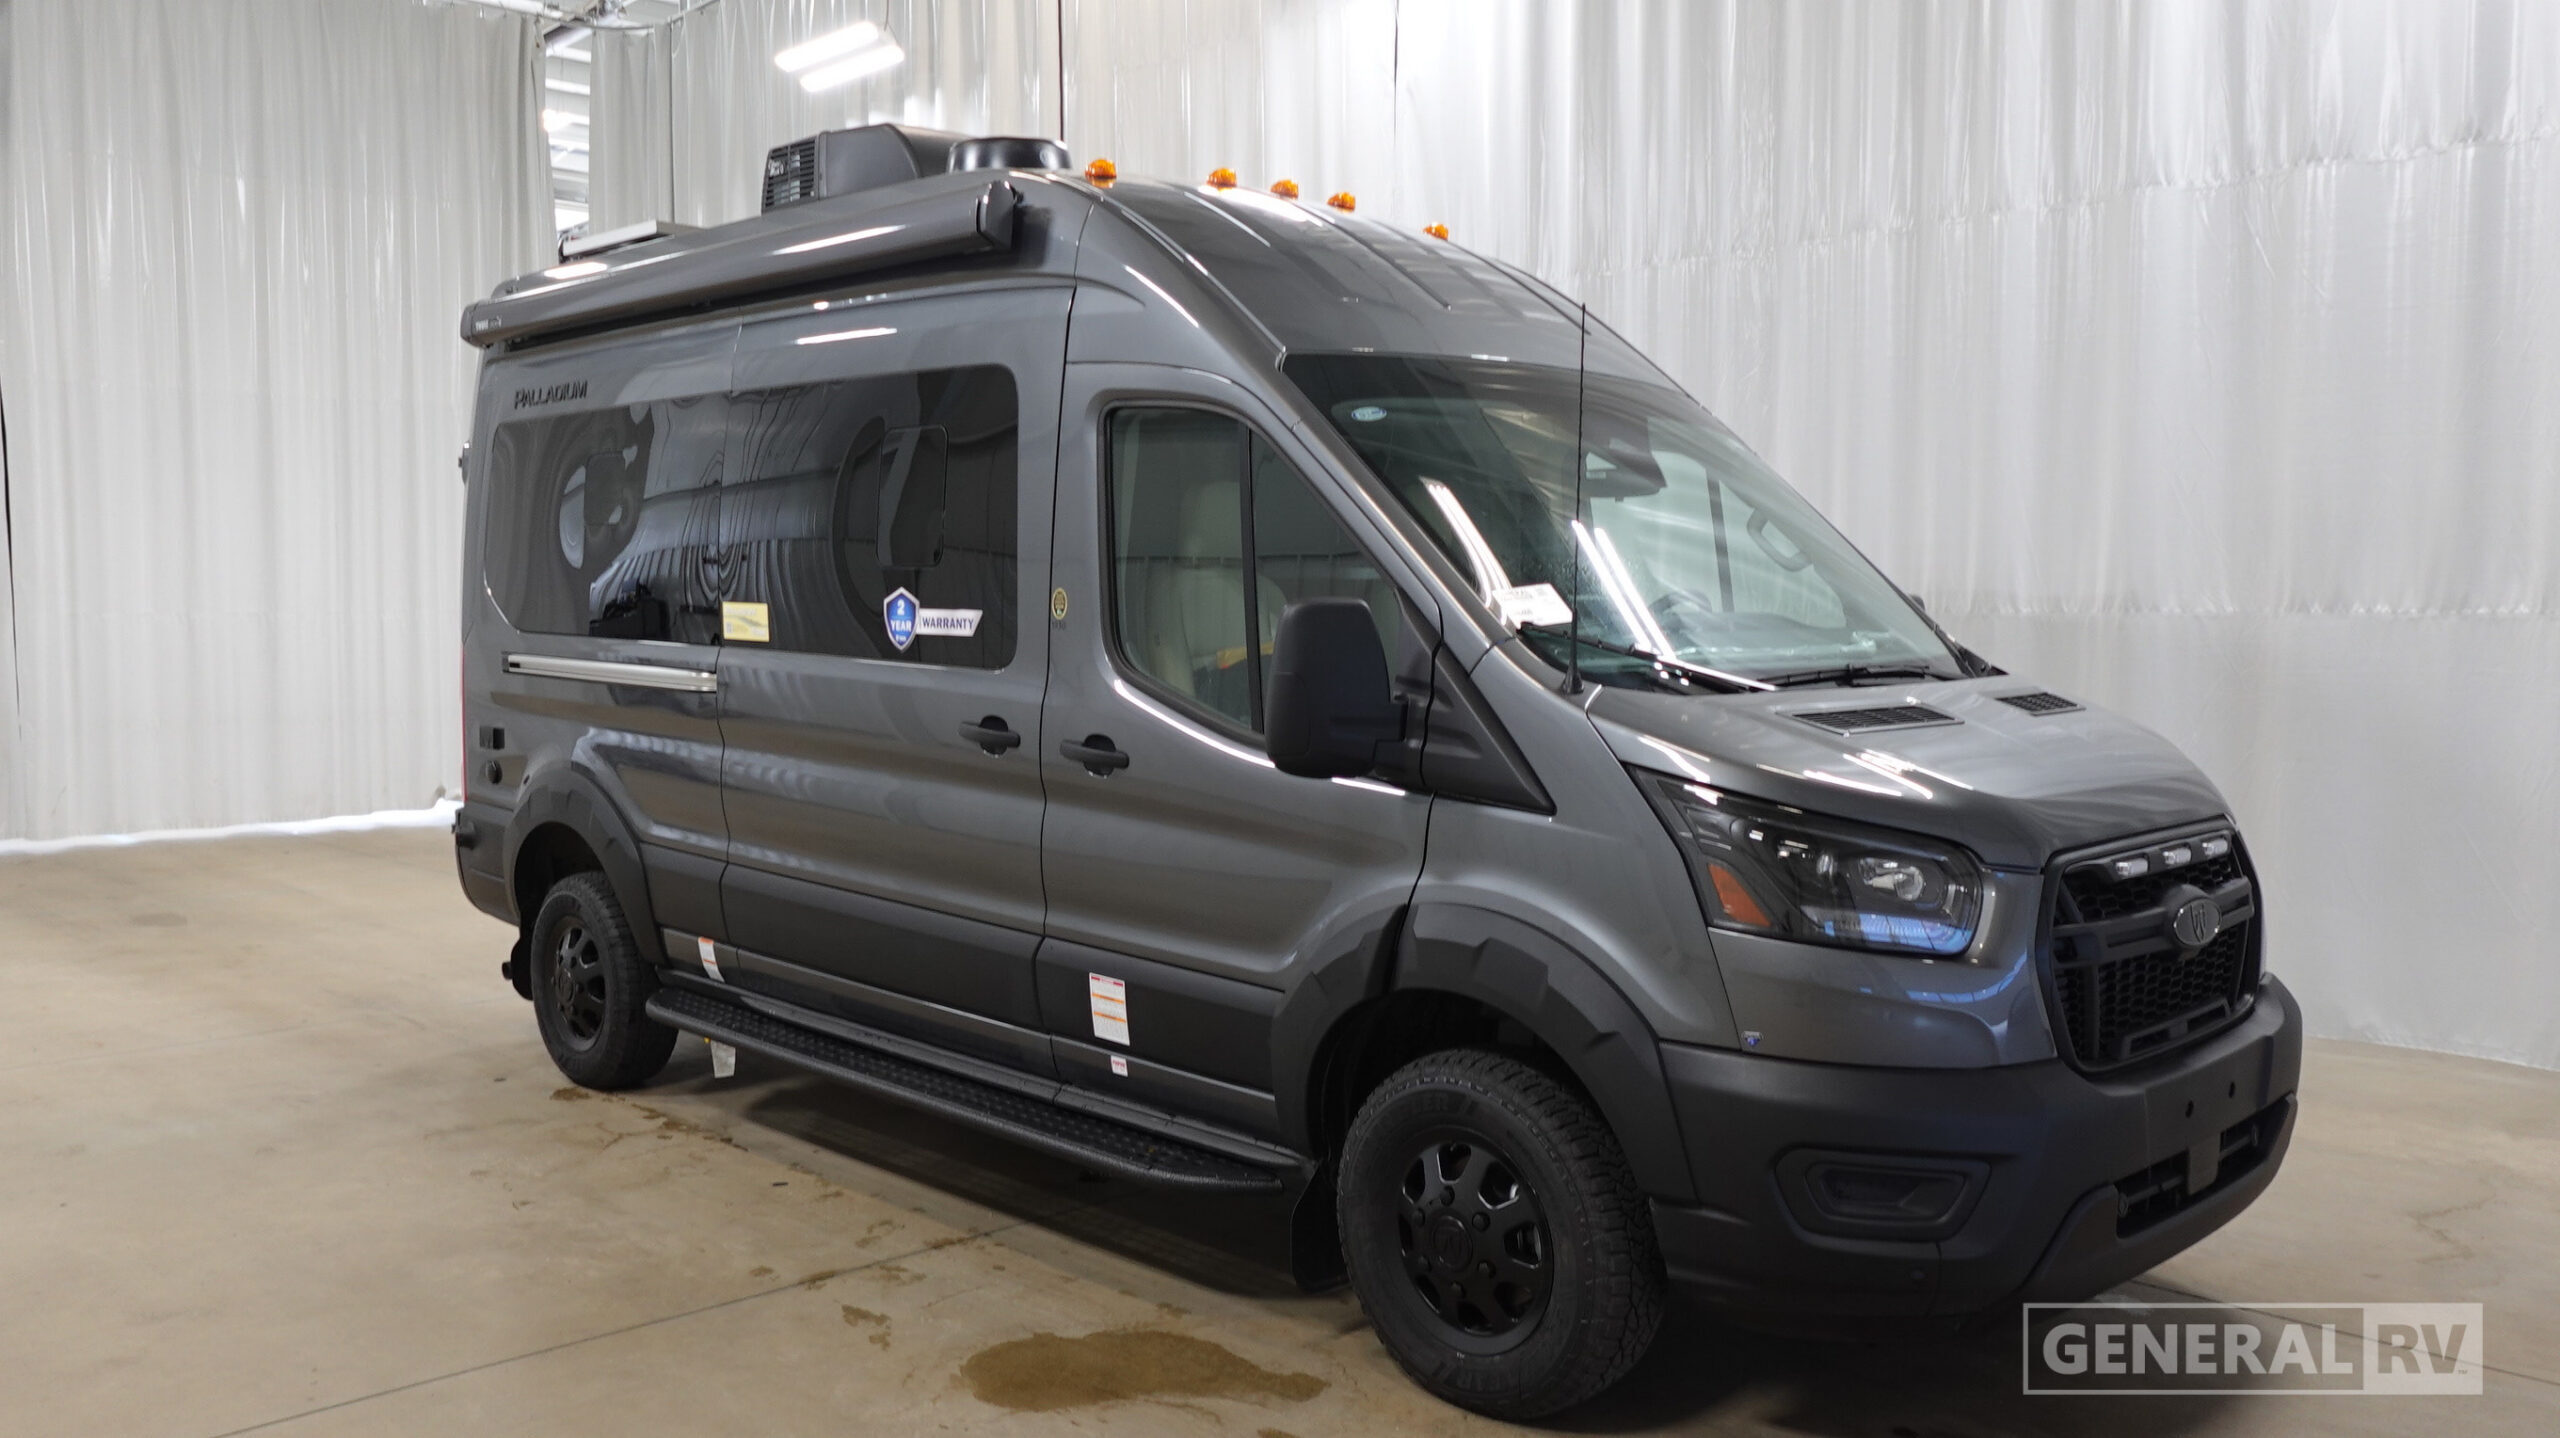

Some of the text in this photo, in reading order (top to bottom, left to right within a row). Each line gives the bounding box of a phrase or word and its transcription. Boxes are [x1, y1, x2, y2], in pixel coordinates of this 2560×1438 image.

[514, 380, 588, 409] PALLADIUM
[897, 599, 905, 616] 2
[891, 620, 912, 632] YEAR
[922, 617, 974, 630] WARRANTY
